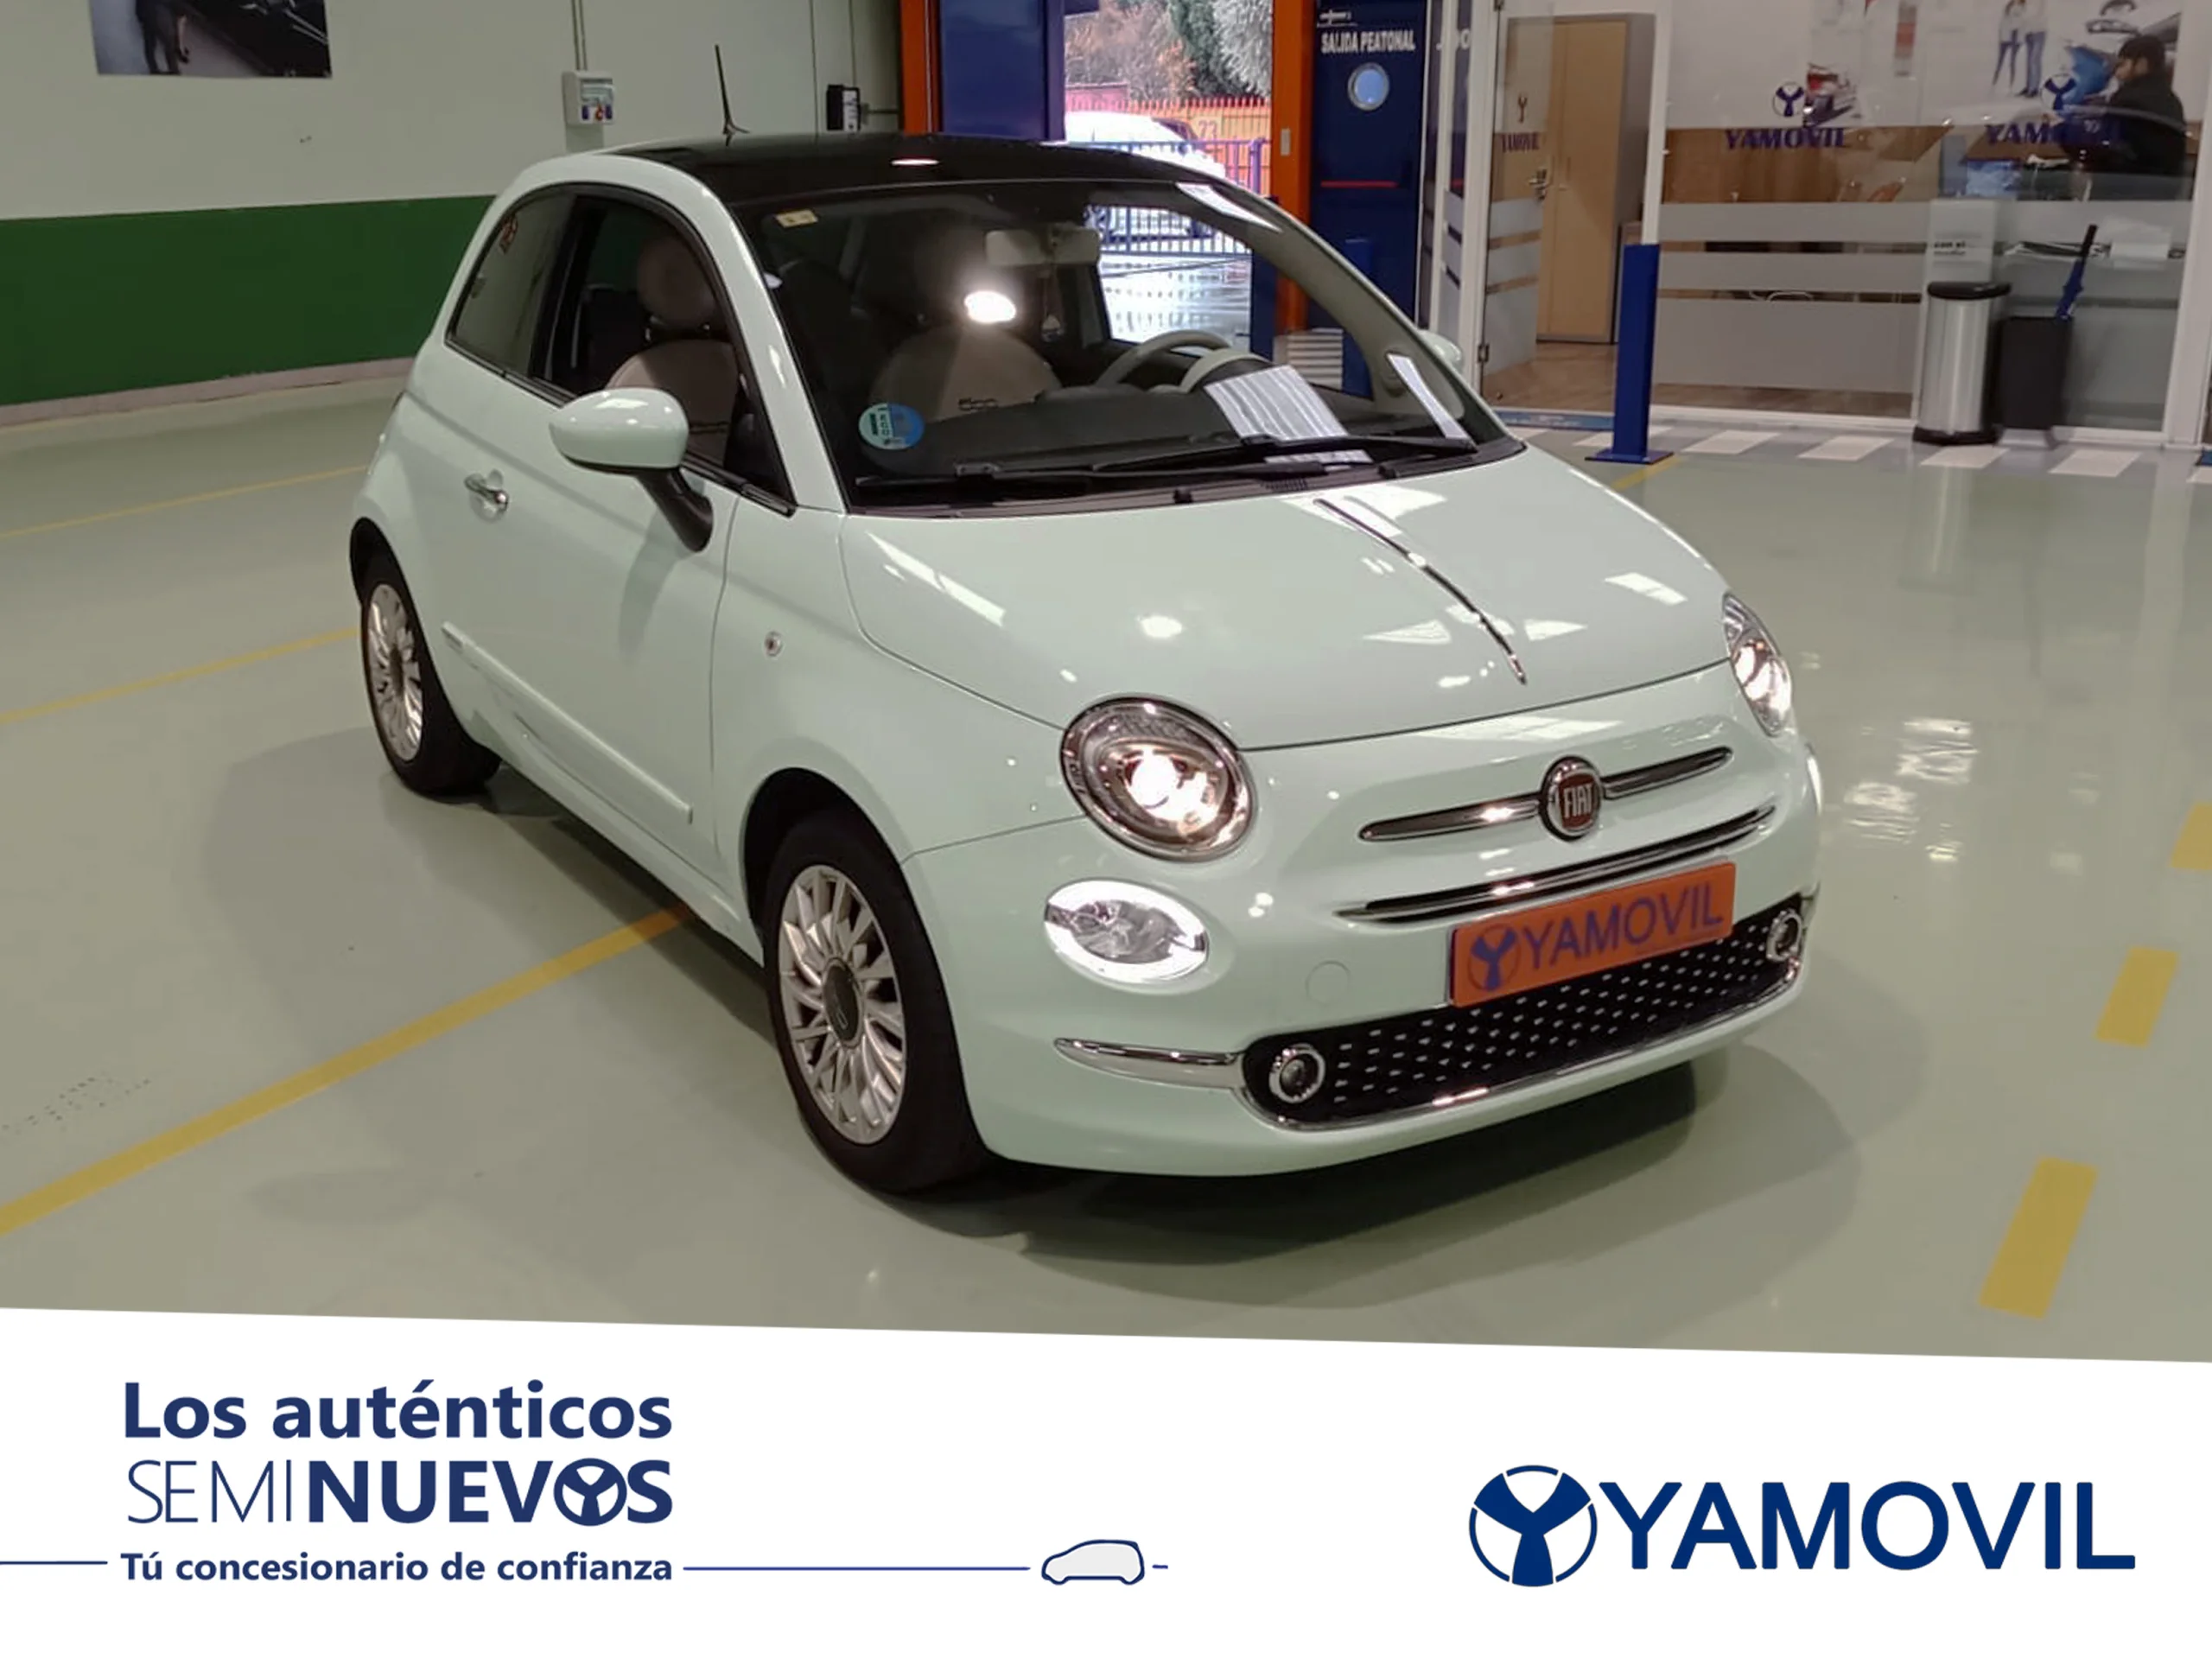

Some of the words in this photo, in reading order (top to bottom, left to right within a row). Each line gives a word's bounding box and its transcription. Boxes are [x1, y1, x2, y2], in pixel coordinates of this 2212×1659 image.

[1321, 31, 1359, 54] SALIDA
[1360, 29, 1415, 53] PEATONAL
[1563, 783, 1592, 818] FIAT
[1522, 881, 1725, 970] YAMOVIL
